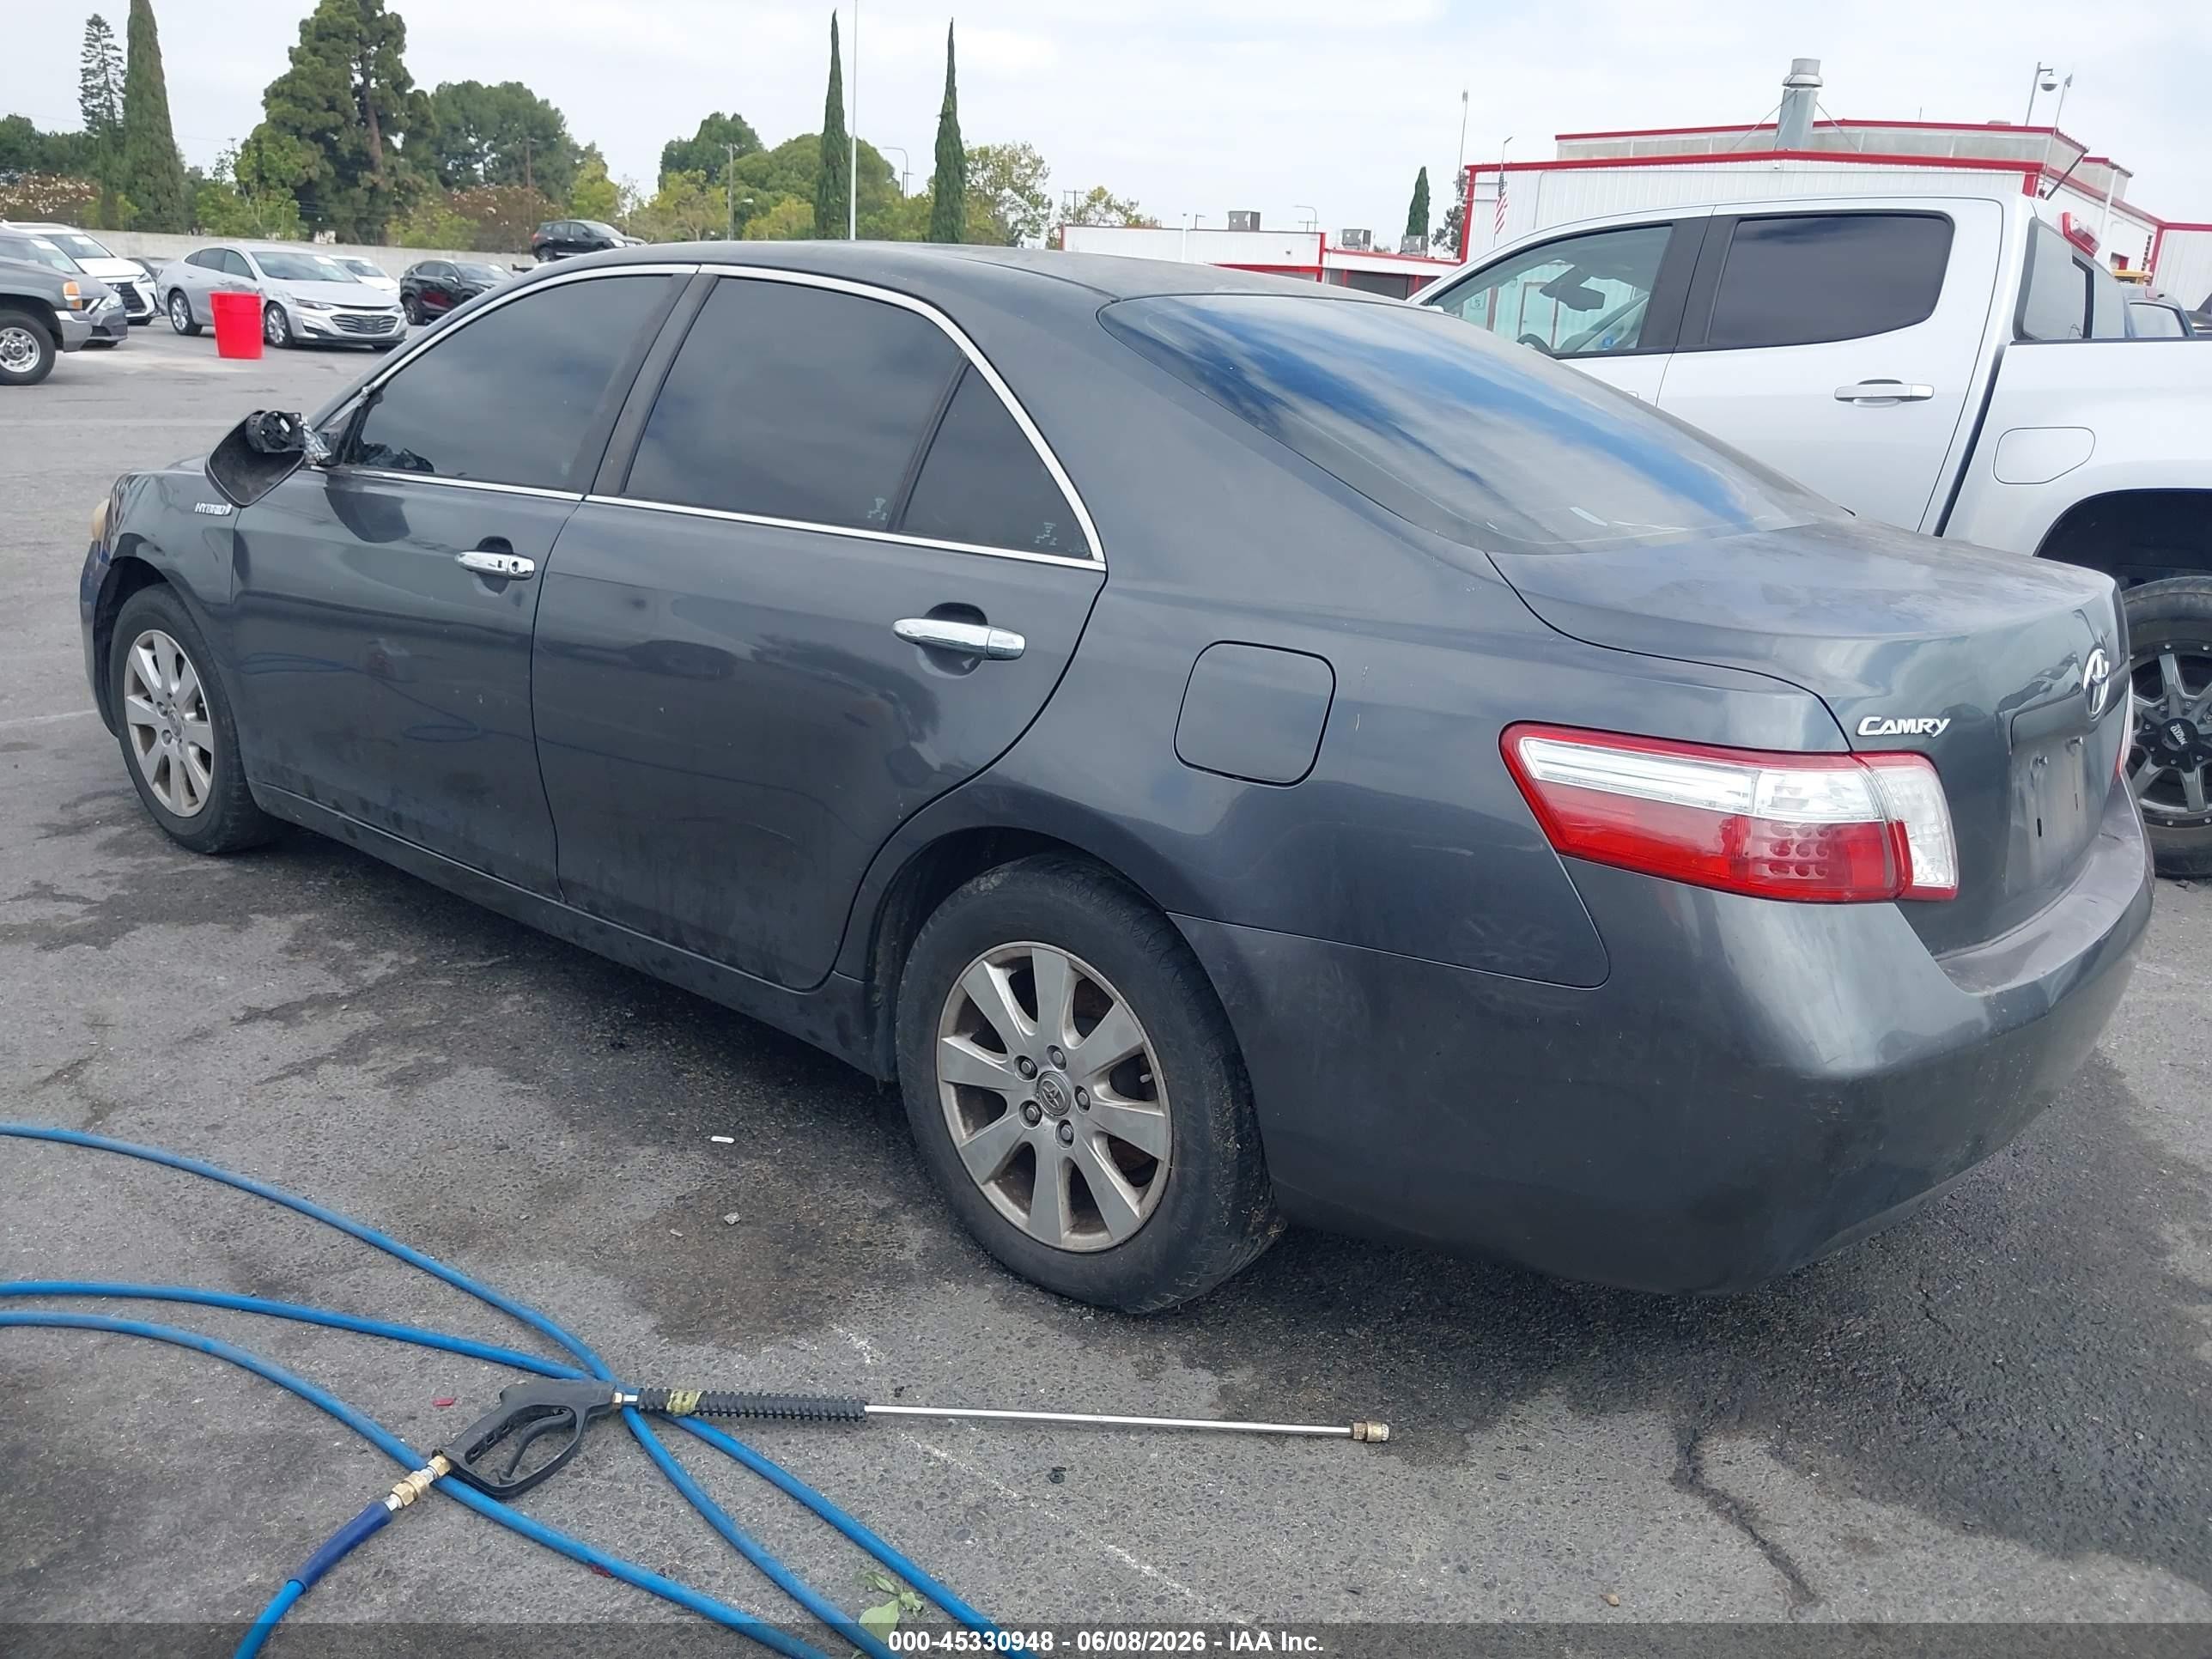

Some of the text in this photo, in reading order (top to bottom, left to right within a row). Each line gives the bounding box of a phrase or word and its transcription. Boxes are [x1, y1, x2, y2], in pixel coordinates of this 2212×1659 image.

[194, 502, 228, 515] HYBRID
[1856, 715, 1952, 738] CAMRY
[2170, 725, 2189, 745] MOTO
